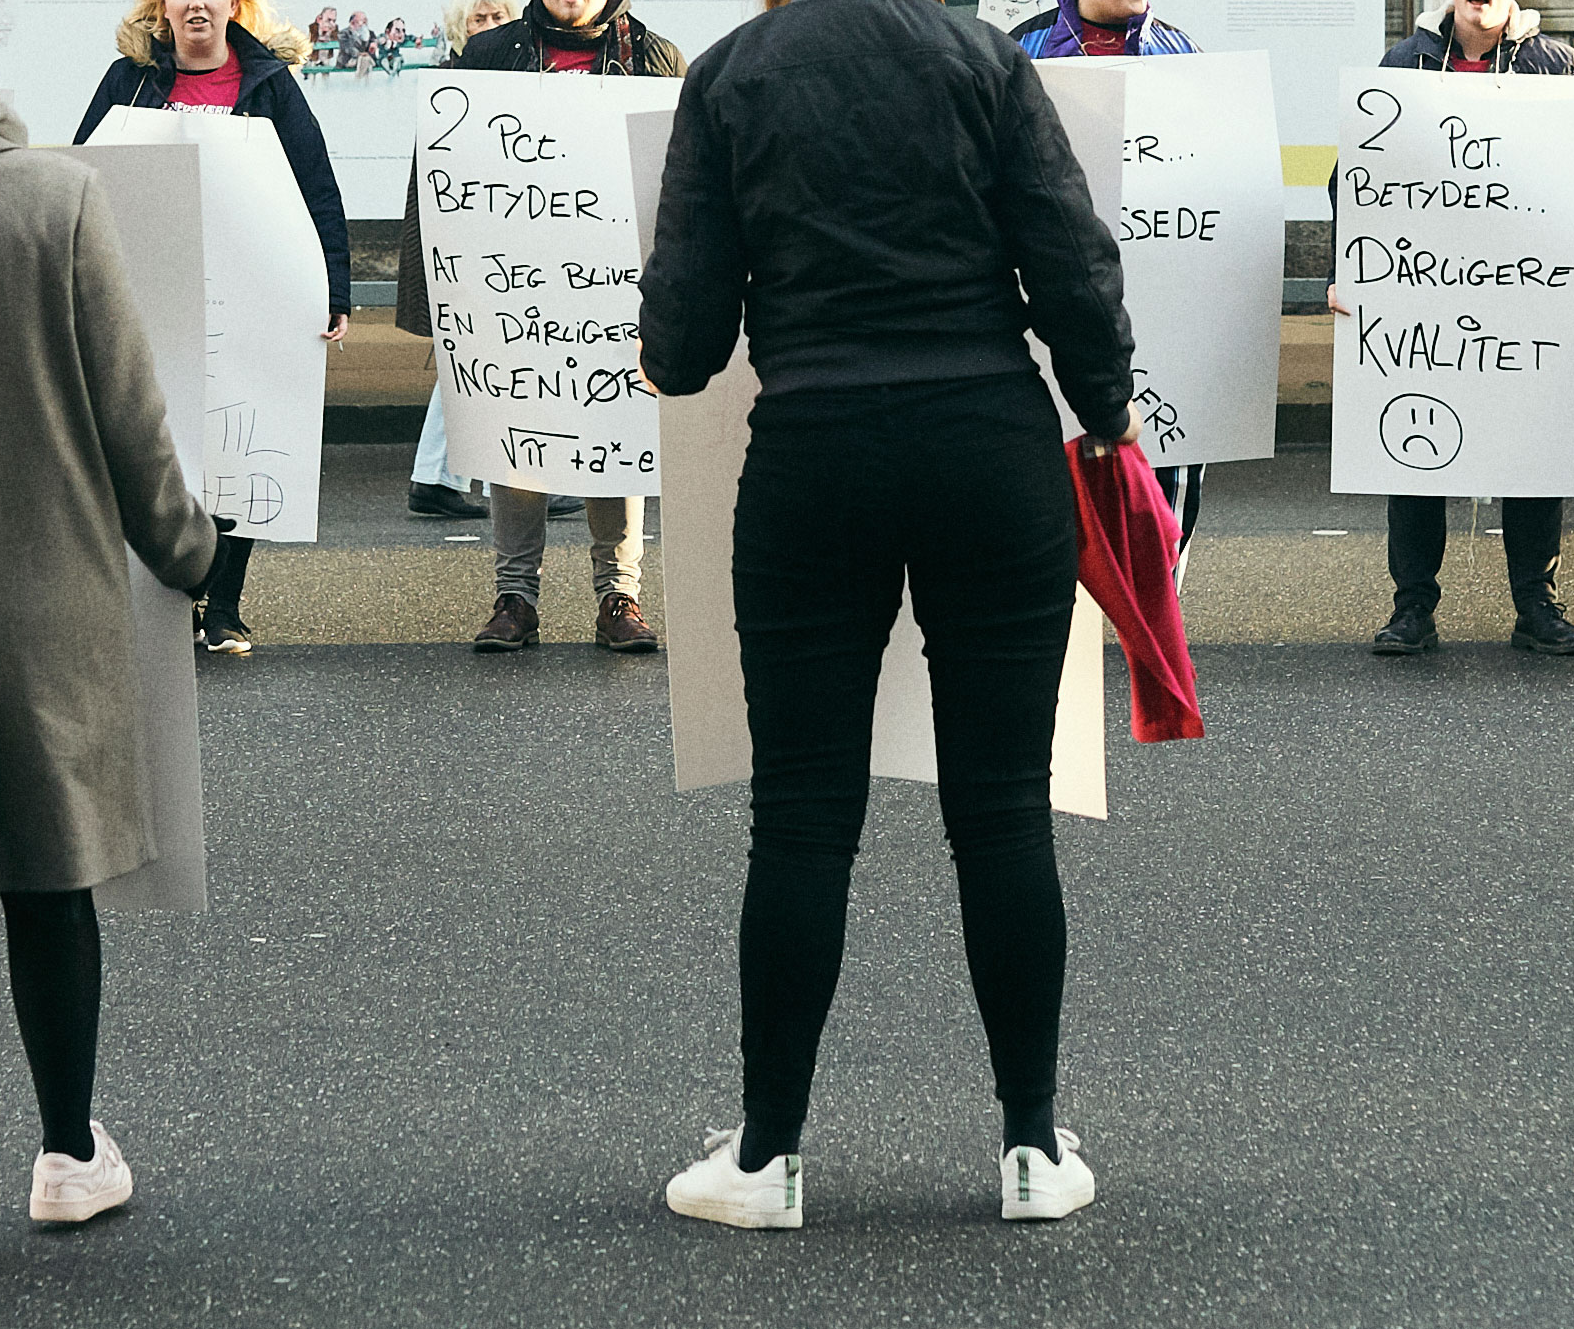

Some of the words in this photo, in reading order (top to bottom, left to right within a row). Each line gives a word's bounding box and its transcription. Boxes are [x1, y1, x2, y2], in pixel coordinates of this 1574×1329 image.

[427, 85, 470, 152] 2
[1356, 88, 1402, 152] 2
[1345, 166, 1546, 214] BETYDER...
[432, 246, 463, 284] AT
[481, 253, 547, 294] JEG
[437, 302, 474, 336] EN
[1358, 304, 1561, 378] KVALITET
